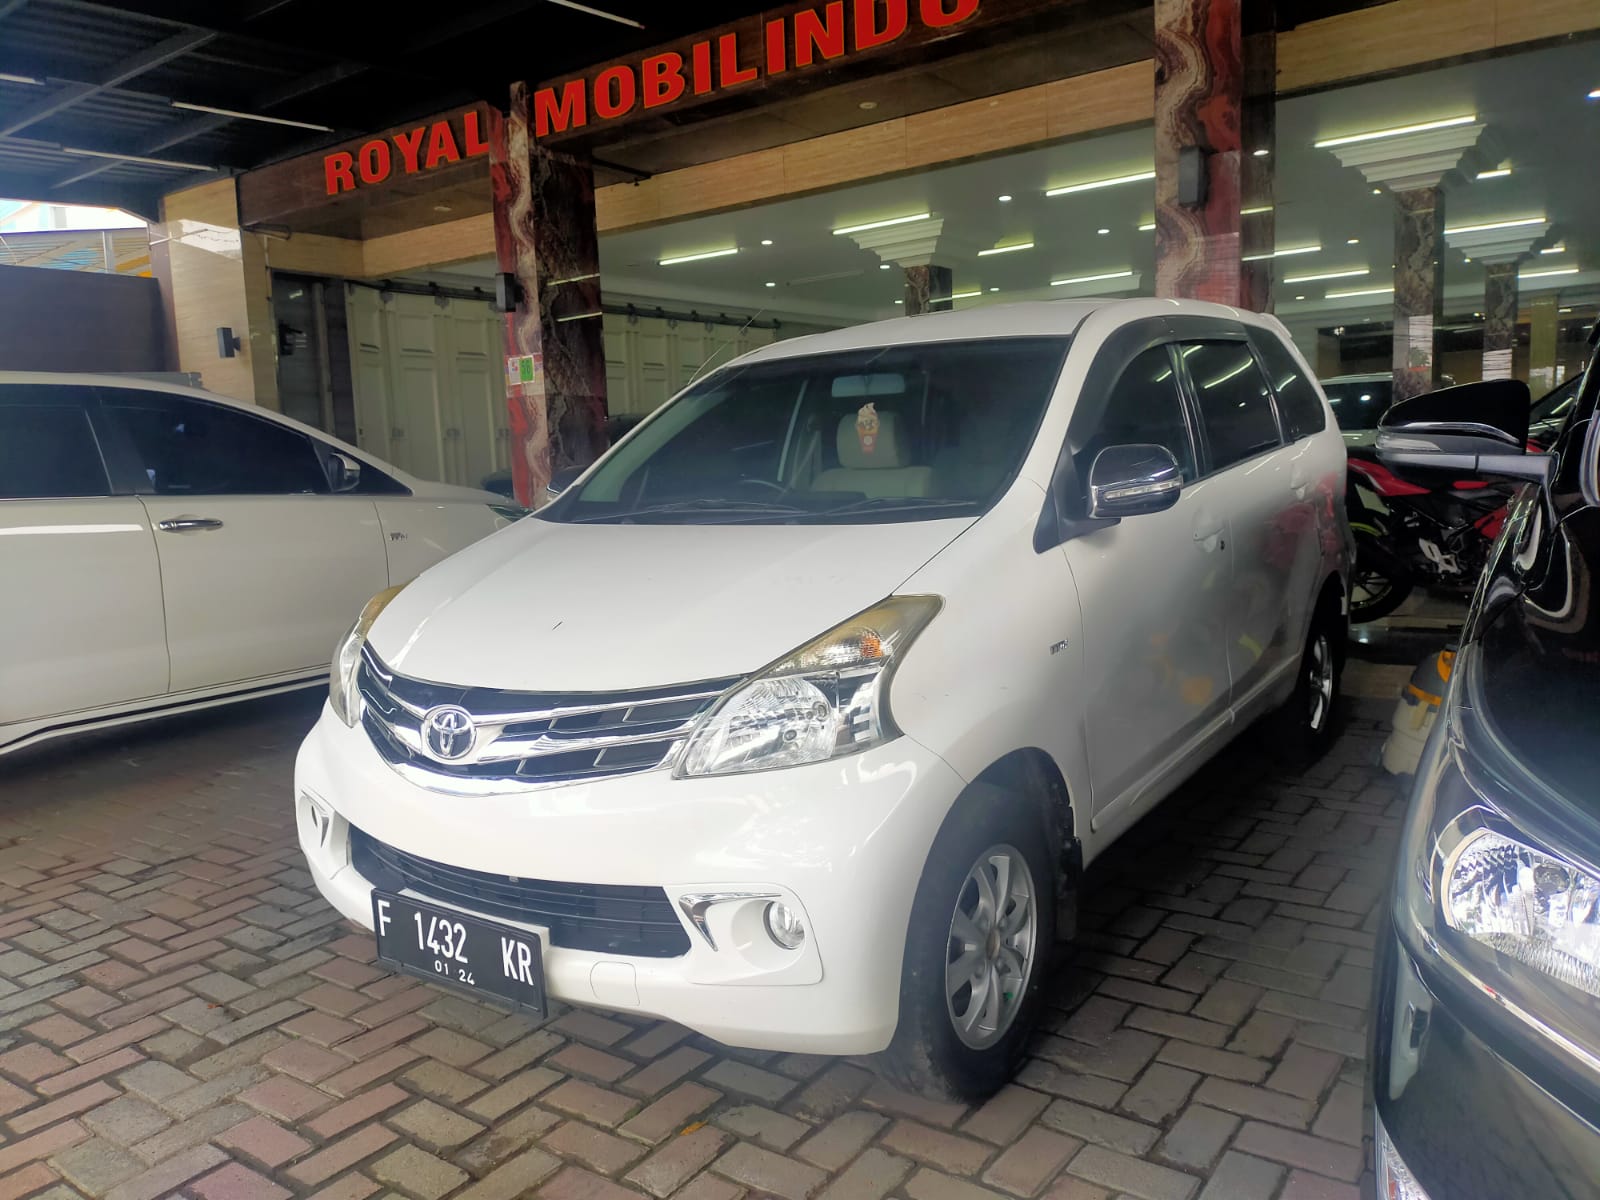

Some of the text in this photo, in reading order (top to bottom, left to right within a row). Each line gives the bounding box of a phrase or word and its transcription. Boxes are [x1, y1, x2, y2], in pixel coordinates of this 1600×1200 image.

[324, 111, 489, 195] ROYAL
[377, 899, 535, 986] F 1432 KR
[434, 960, 475, 985] 01 24
